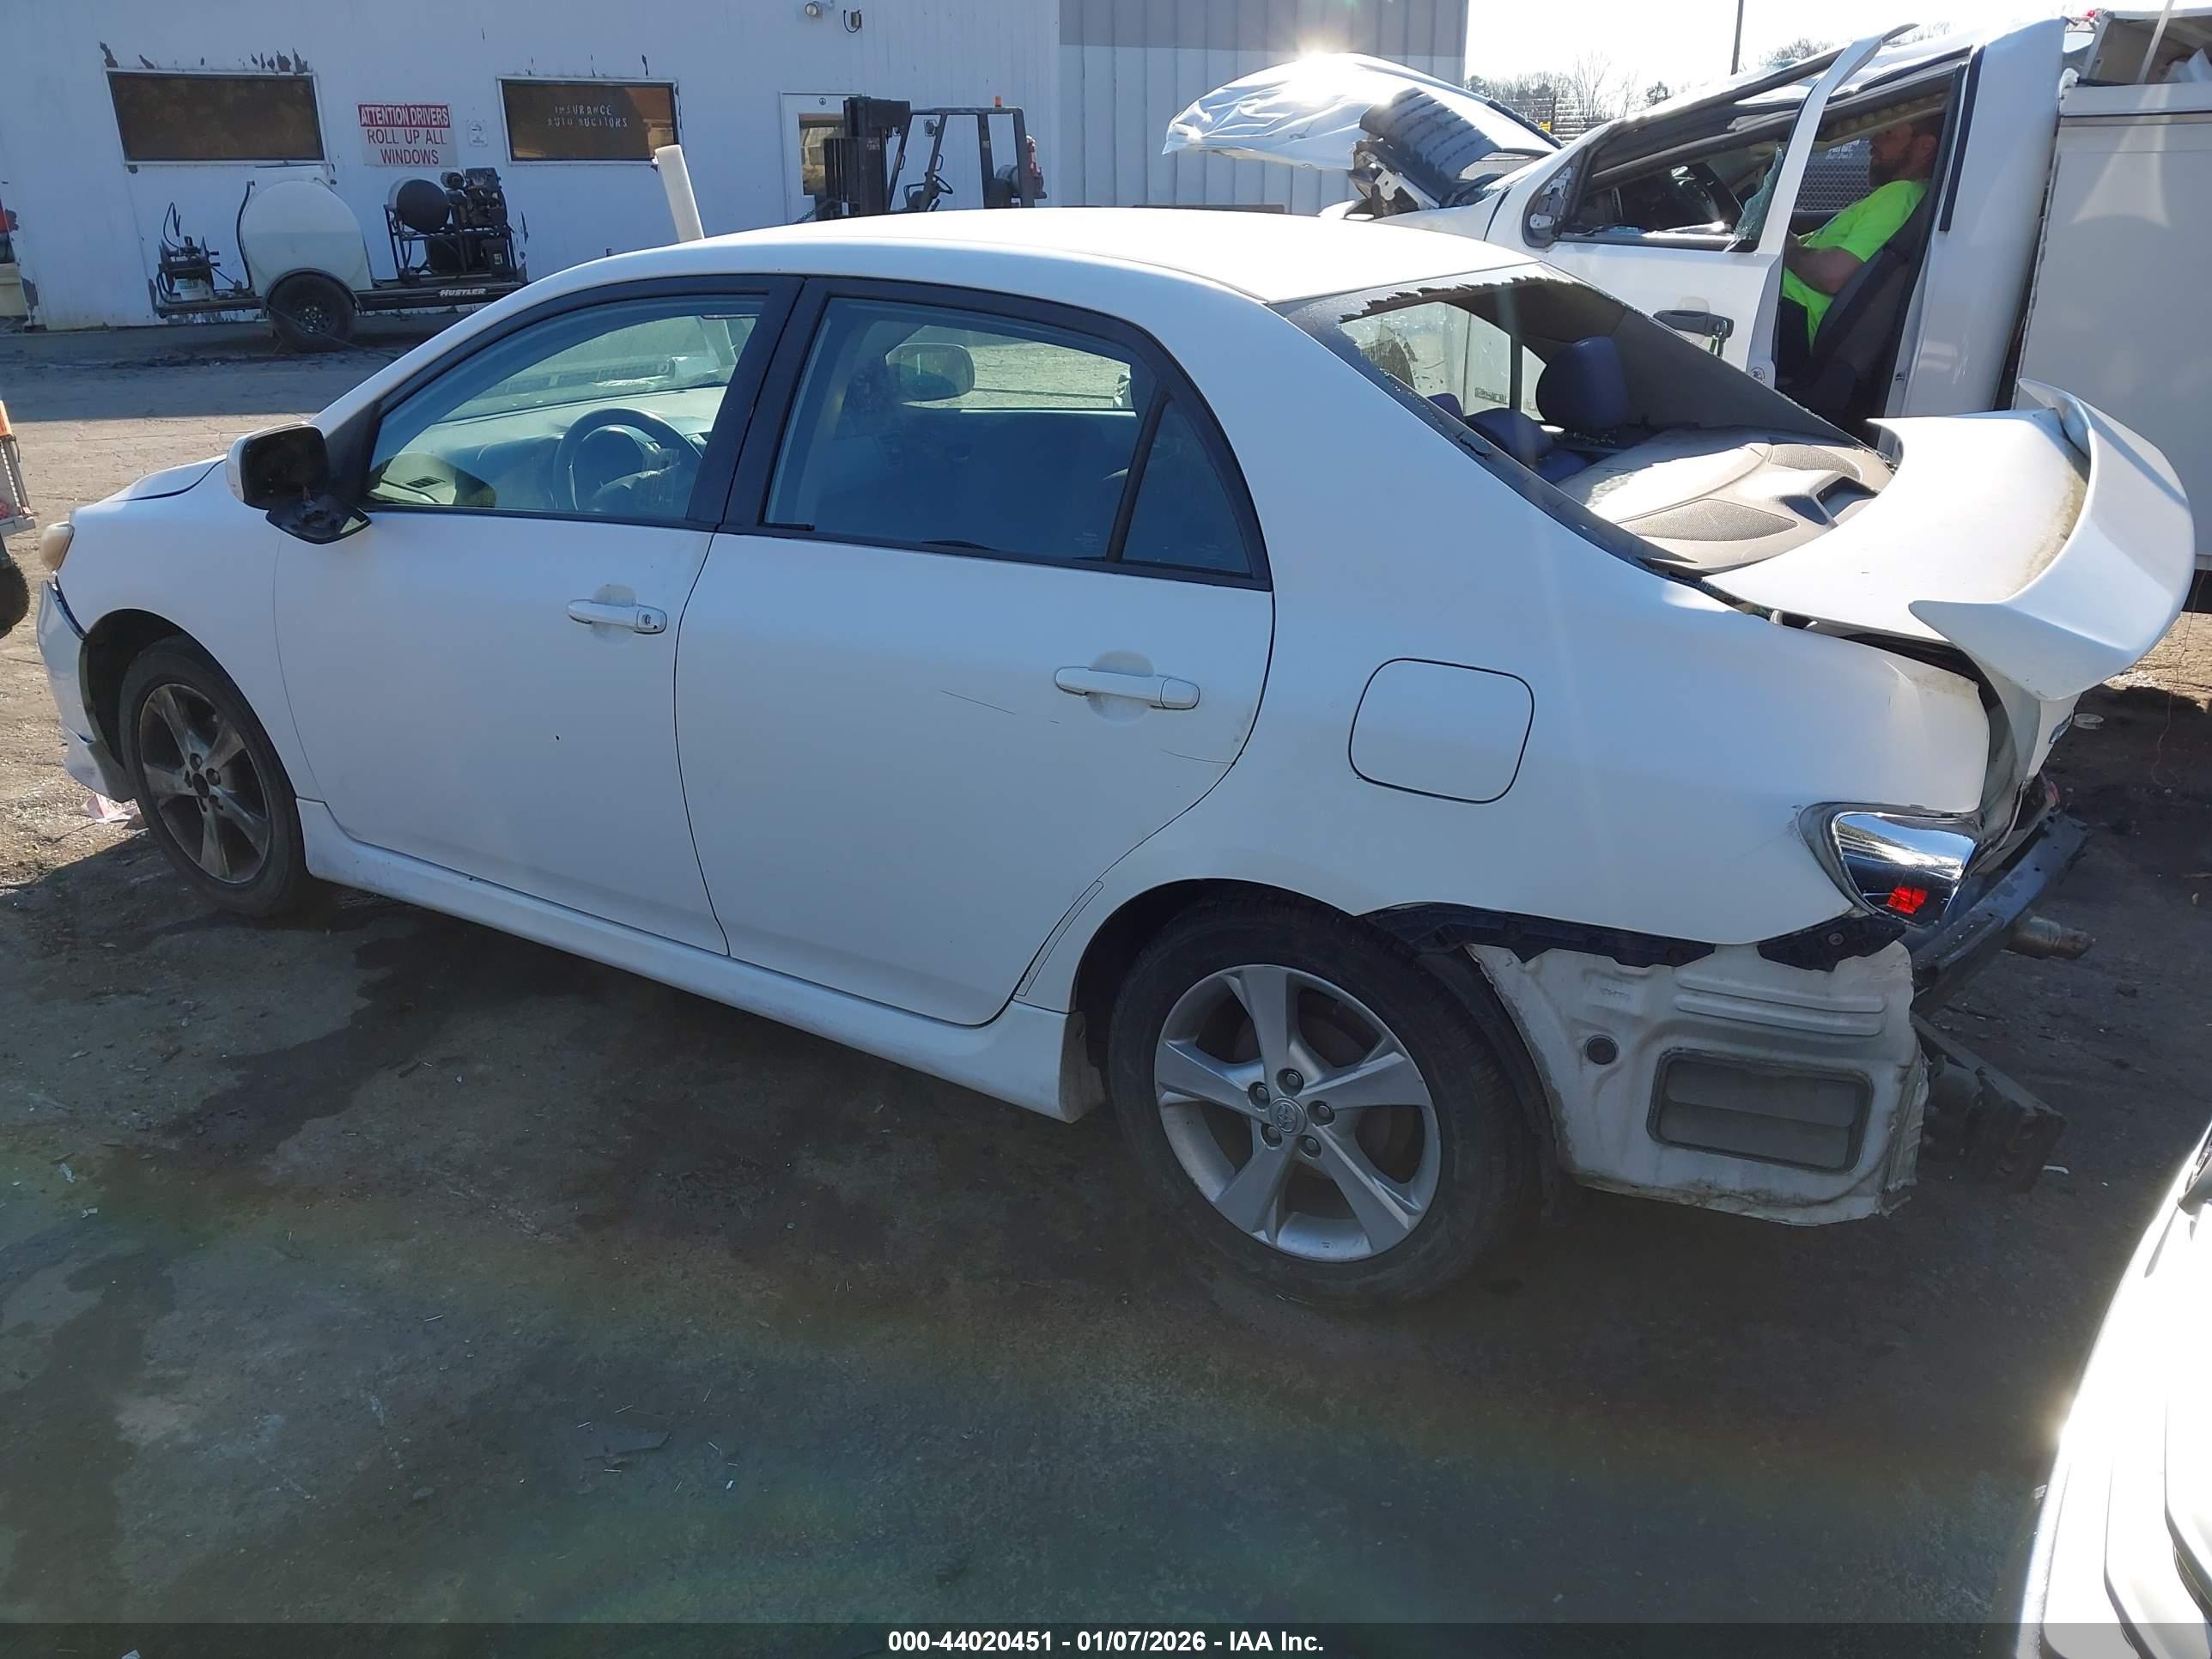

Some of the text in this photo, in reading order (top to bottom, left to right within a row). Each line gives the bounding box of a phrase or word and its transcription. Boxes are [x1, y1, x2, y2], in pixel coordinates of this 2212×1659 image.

[361, 106, 448, 126] ATTENTION DRIVERS
[367, 129, 447, 145] ROLL UP ALL
[380, 149, 439, 165] WINDOWS
[439, 288, 487, 296] HUSTLER
